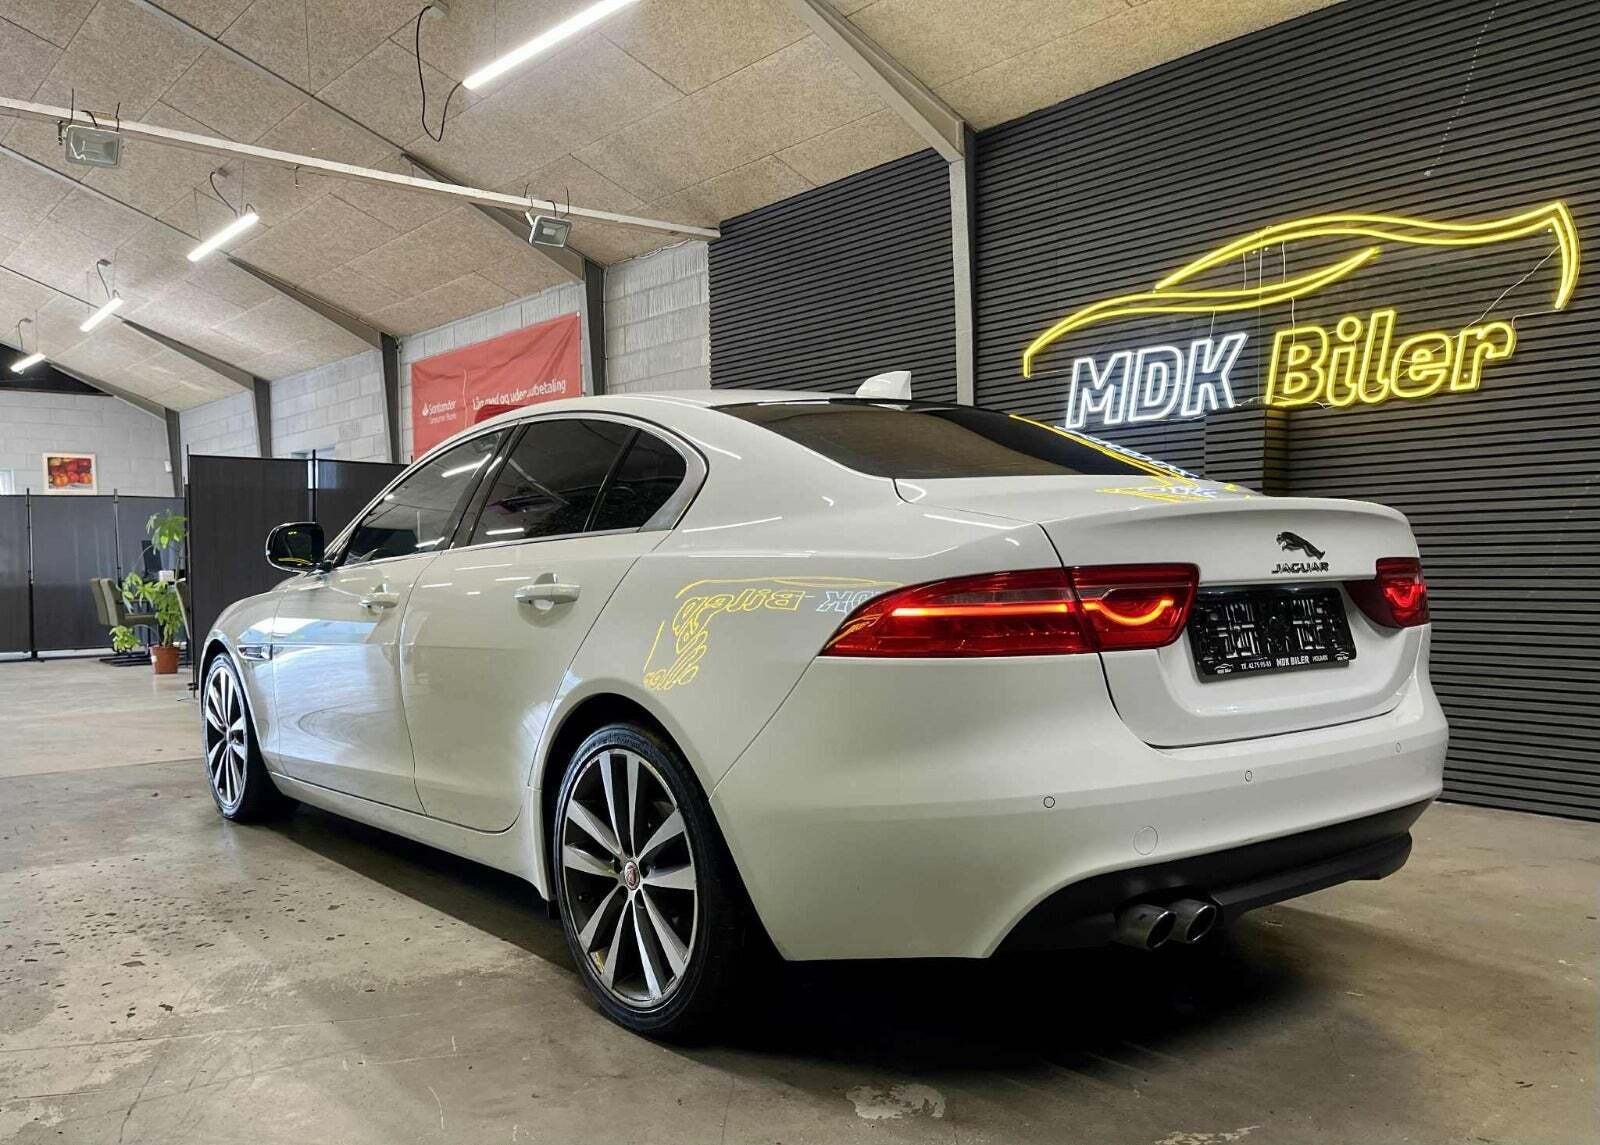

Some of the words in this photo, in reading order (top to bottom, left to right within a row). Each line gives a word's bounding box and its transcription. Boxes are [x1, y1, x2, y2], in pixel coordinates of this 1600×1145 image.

[1065, 332, 1248, 430] MDK
[1265, 309, 1517, 408] Biler
[527, 379, 566, 398] betaling
[1271, 562, 1329, 574] JAGUAR
